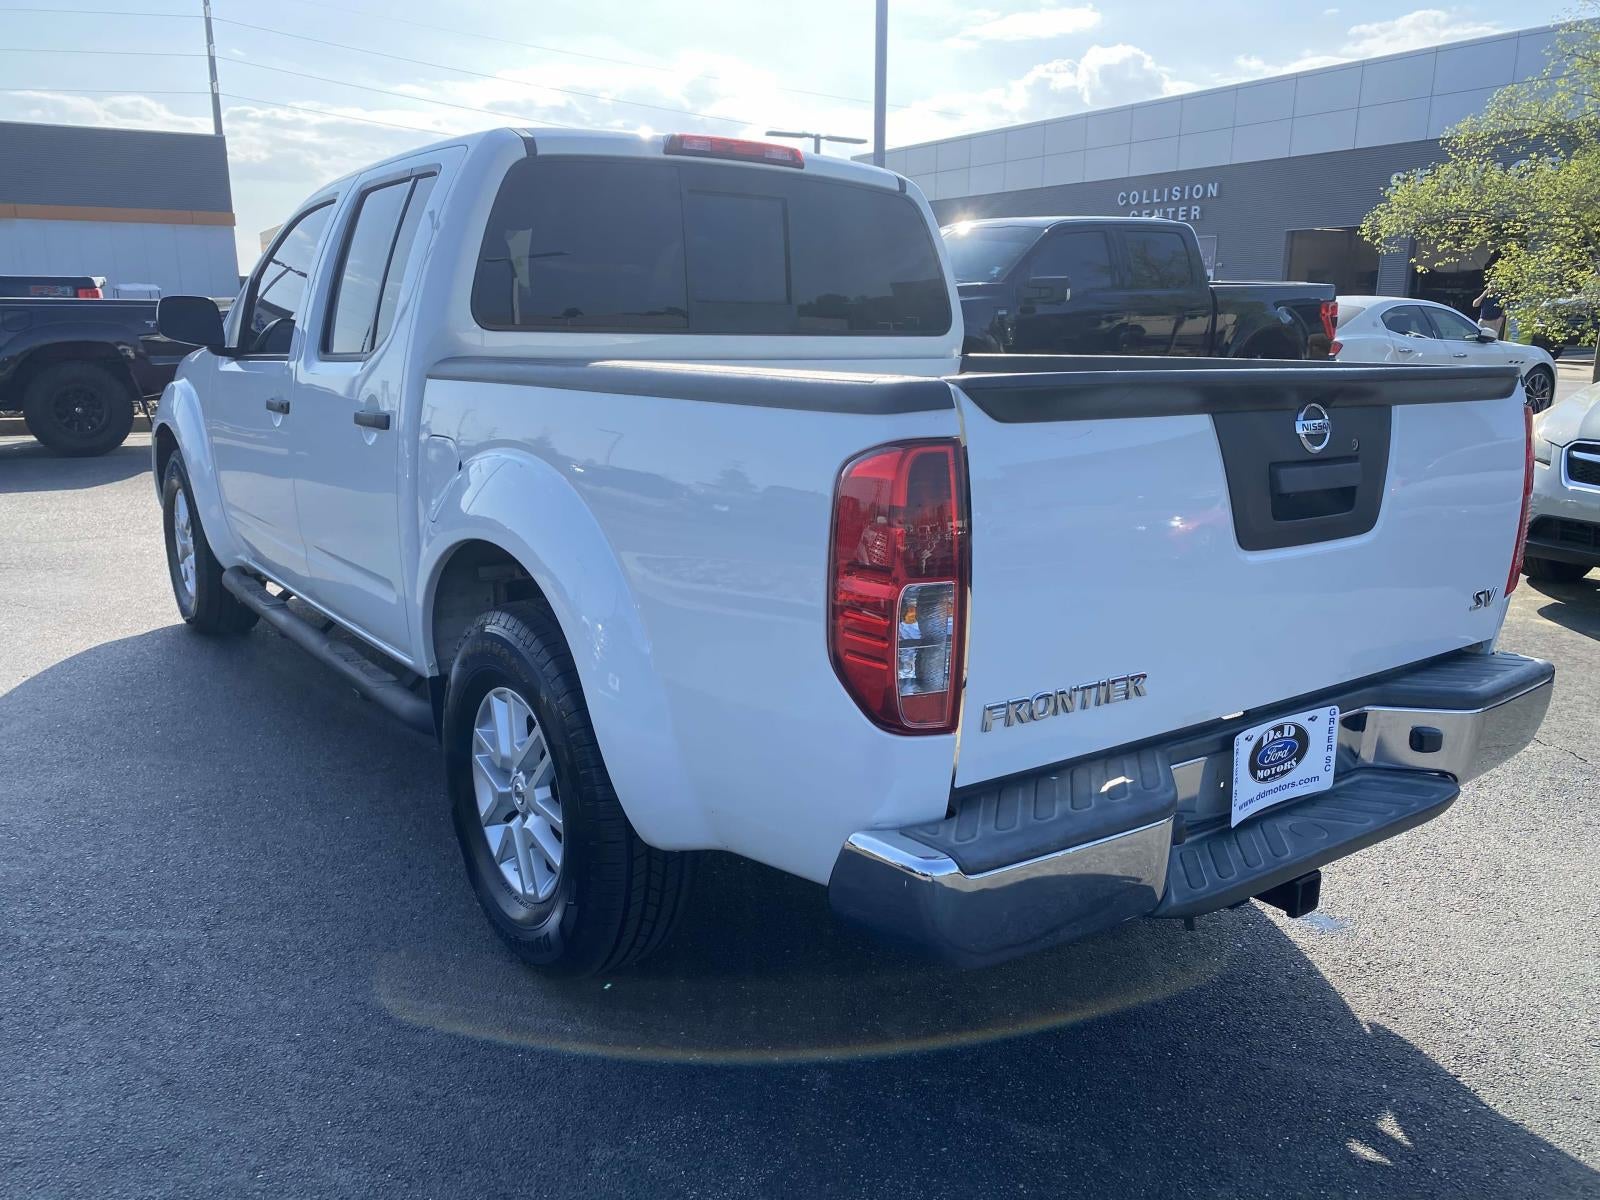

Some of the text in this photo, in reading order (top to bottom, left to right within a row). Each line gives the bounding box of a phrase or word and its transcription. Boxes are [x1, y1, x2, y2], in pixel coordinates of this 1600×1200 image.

[1117, 182, 1218, 206] COLLISION
[1301, 422, 1331, 432] NISSAN
[1469, 586, 1498, 611] SV
[981, 671, 1148, 733] FRONTIER
[1262, 724, 1296, 748] D&D
[1264, 743, 1291, 763] Ford
[1256, 757, 1297, 780] MOTORS
[1238, 775, 1320, 811] www.ddmotors.com
